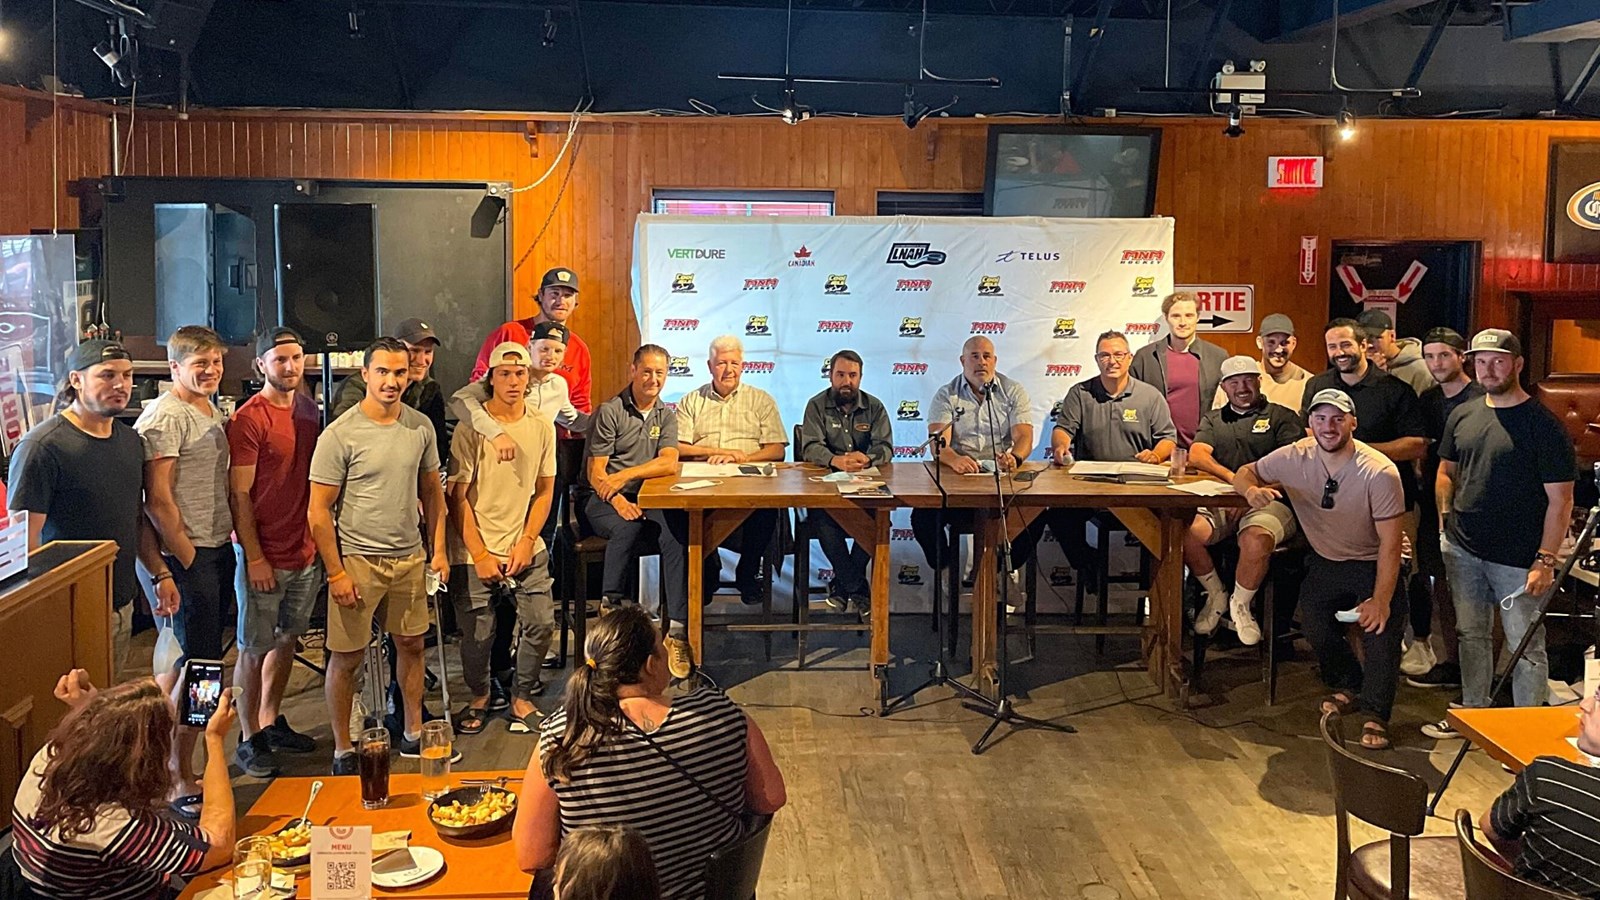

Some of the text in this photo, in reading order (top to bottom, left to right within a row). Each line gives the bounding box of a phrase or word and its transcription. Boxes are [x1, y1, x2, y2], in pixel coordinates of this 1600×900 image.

[668, 248, 726, 260] VERTDURE
[892, 247, 924, 260] LNAH
[1020, 252, 1060, 261] TELUS
[788, 259, 815, 267] CANADIAN
[1198, 292, 1246, 311] RTIE
[0, 357, 20, 451] ORTIE
